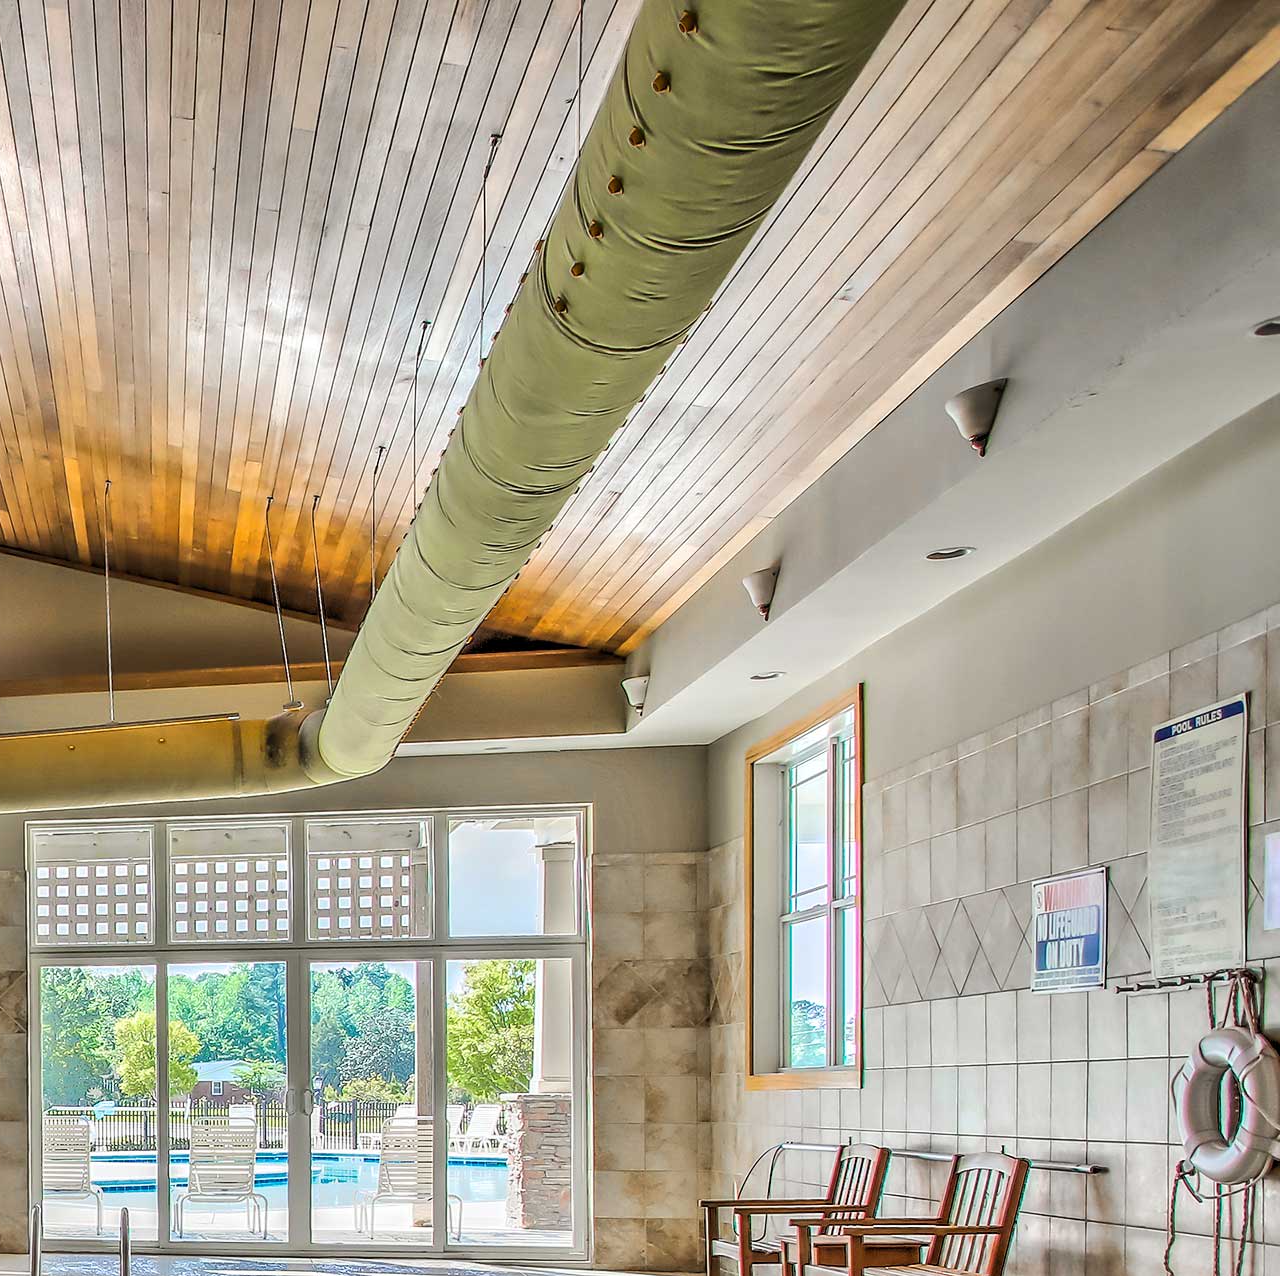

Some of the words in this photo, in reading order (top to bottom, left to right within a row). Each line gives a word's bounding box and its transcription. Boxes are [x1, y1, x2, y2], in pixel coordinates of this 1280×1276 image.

[1171, 720, 1193, 736] POOL
[1195, 709, 1223, 728] RULES
[1045, 940, 1059, 970] ON
[1059, 936, 1085, 969] DUTY
